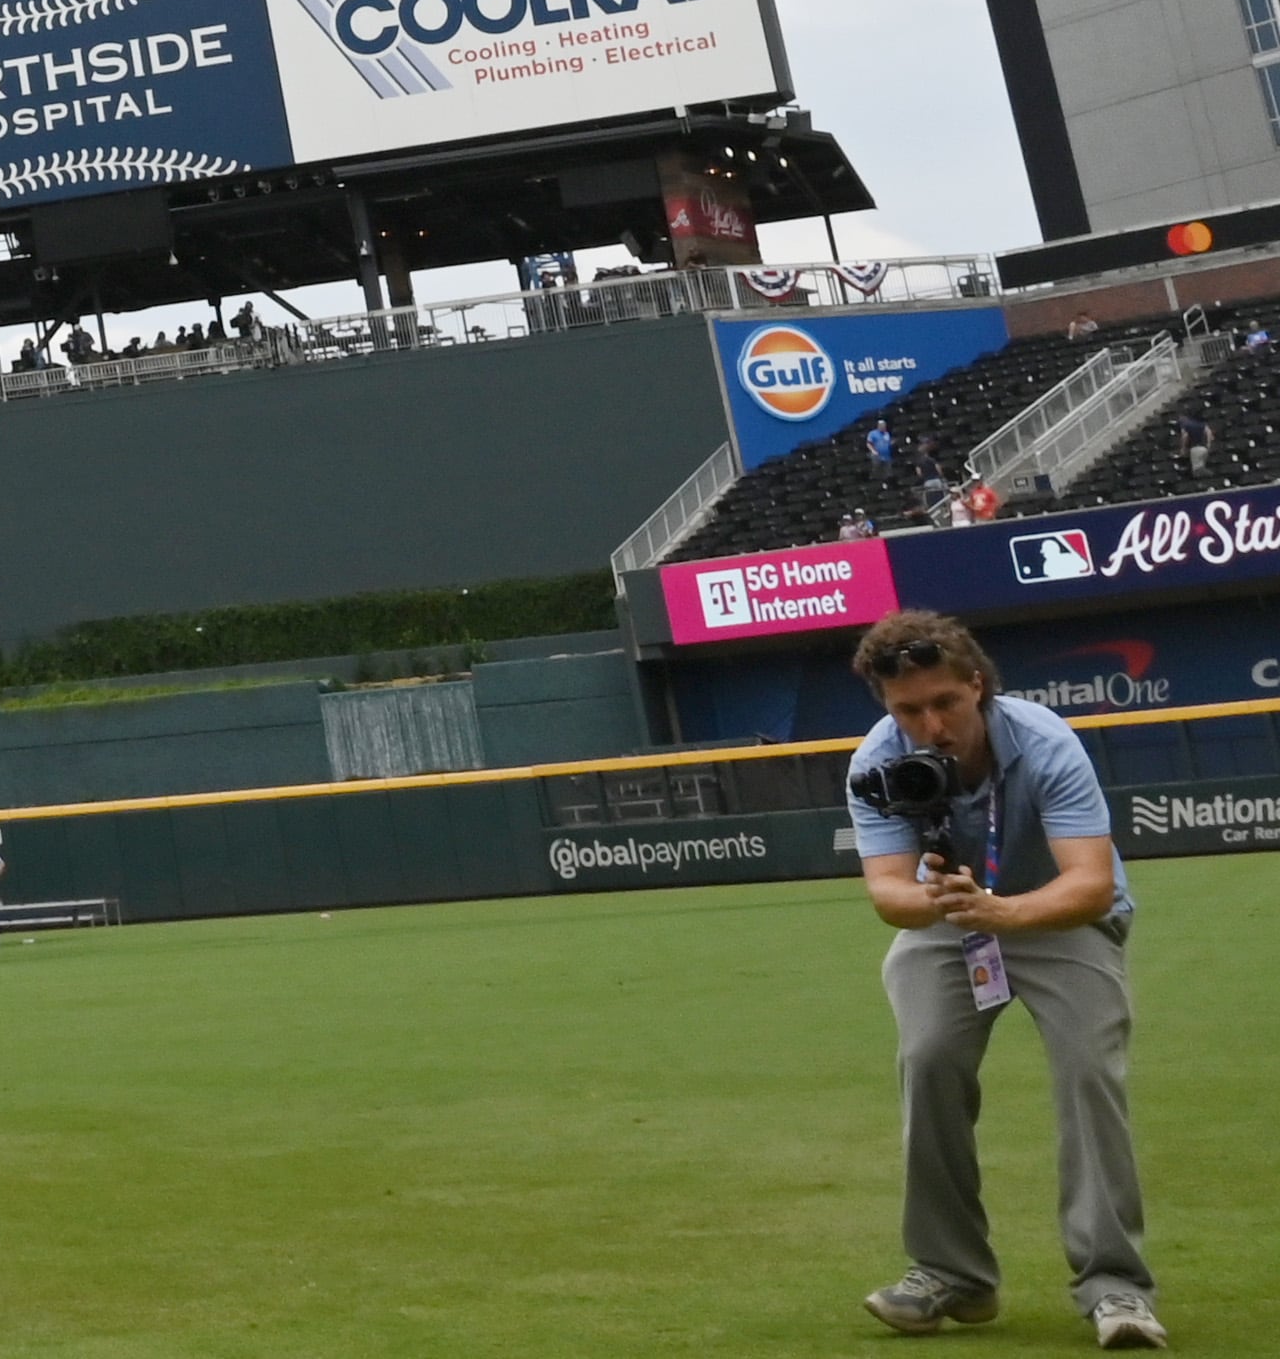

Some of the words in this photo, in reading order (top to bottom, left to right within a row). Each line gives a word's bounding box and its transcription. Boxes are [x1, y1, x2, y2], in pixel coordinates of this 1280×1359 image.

[448, 38, 538, 66] Cooling
[558, 21, 651, 49] Heating
[474, 55, 585, 86] Plumbing
[605, 31, 718, 66] Electrical
[748, 356, 827, 388] Gulf
[843, 359, 856, 374] It
[857, 356, 874, 373] all
[877, 357, 917, 371] starts
[847, 373, 902, 394] here
[1100, 510, 1190, 577] All
[1198, 500, 1280, 565] Sta
[746, 564, 779, 591] 5G
[782, 560, 853, 587] Home
[751, 589, 848, 622] Internet
[1172, 793, 1280, 829] Nation
[1222, 828, 1249, 842] Car
